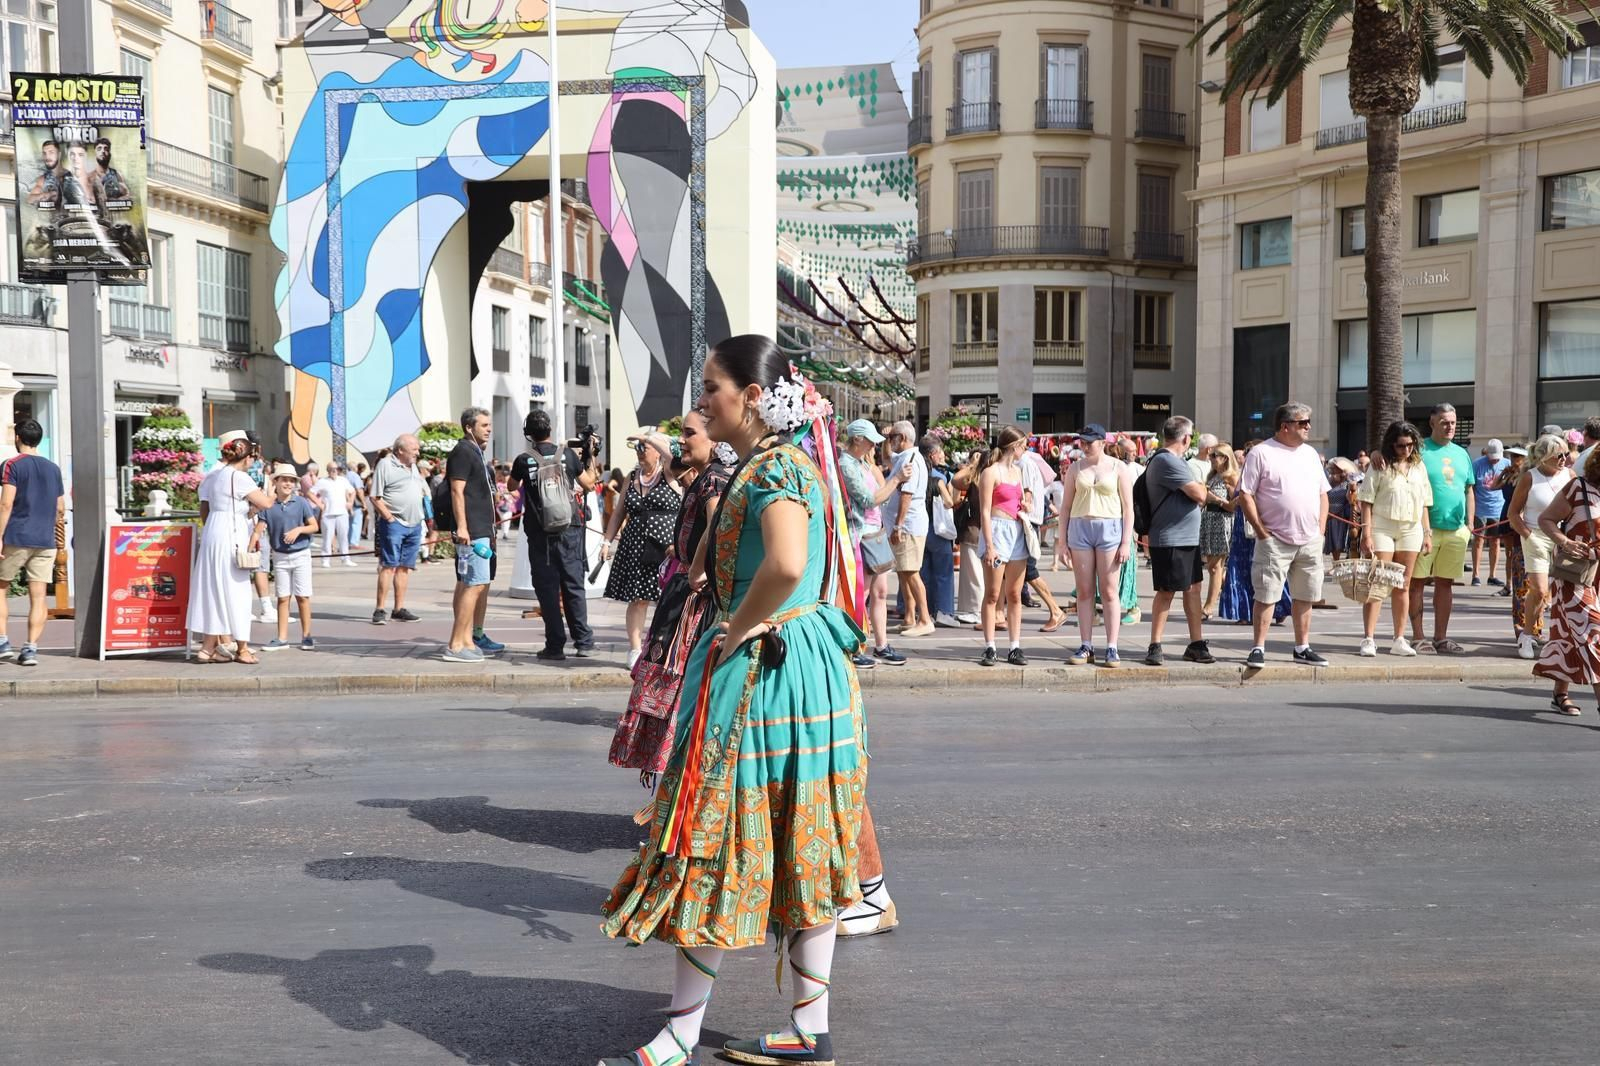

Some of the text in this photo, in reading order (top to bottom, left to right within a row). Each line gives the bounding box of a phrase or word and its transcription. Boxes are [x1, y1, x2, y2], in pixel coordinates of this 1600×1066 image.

[15, 78, 116, 102] 2 AGOSTO
[17, 108, 137, 120] PLAZA TOROS LA MALAGUETA
[53, 126, 98, 143] BOXEO
[1402, 268, 1450, 286] ixaBank
[129, 346, 160, 361] helvetia
[214, 356, 241, 369] helvetia
[531, 385, 545, 397] BBVA
